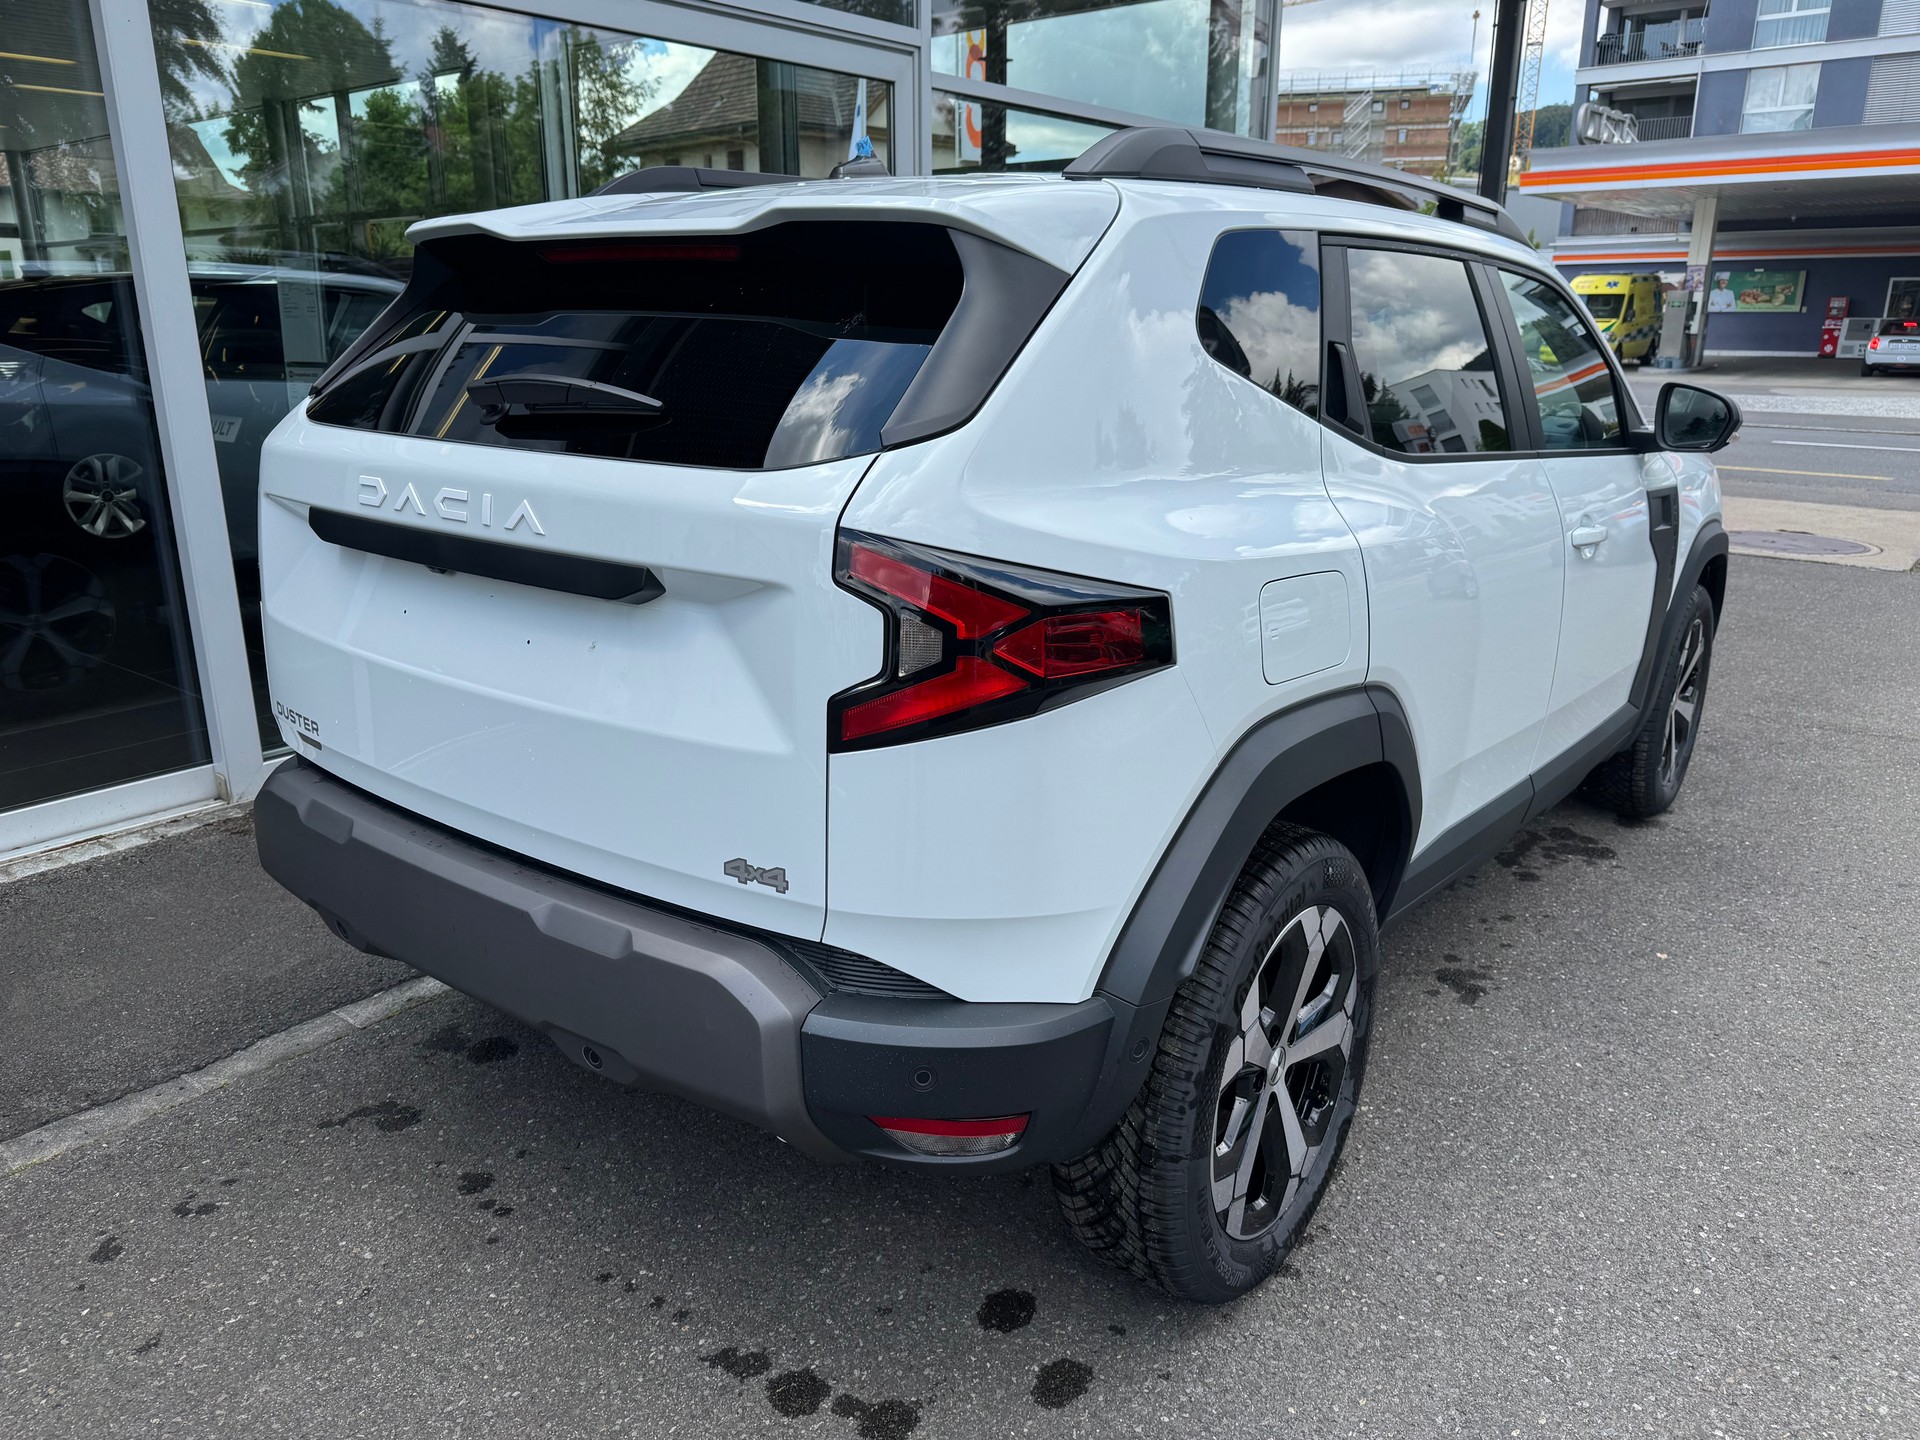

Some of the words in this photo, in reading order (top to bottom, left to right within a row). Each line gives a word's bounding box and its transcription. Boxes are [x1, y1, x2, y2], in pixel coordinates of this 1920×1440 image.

[213, 420, 235, 436] ULT
[358, 474, 545, 536] DACIA
[276, 700, 320, 737] DUSTER
[724, 857, 788, 894] 4x4
